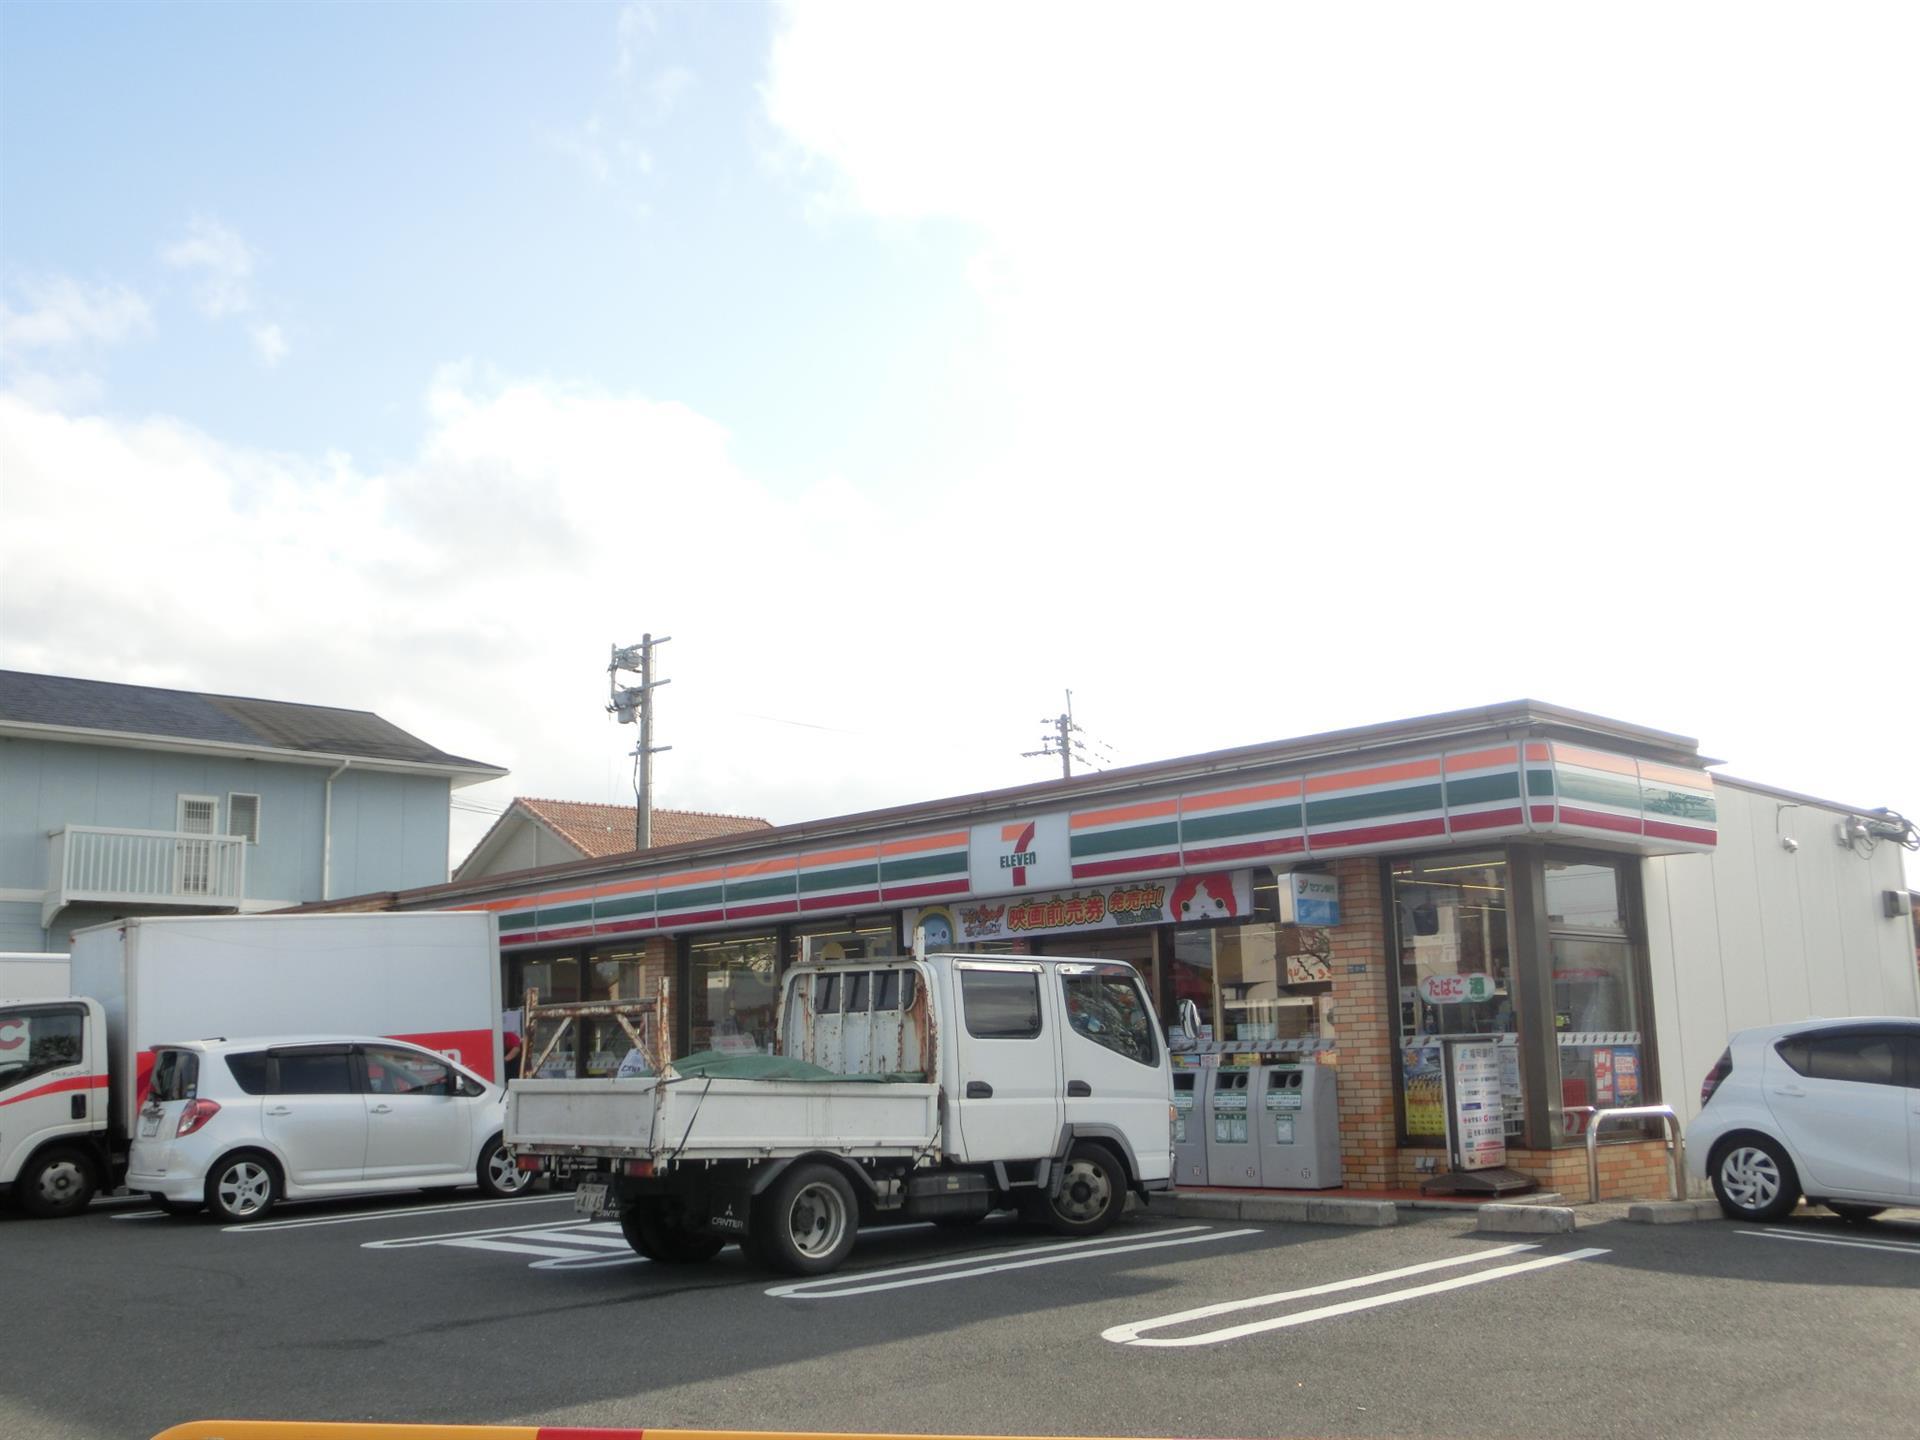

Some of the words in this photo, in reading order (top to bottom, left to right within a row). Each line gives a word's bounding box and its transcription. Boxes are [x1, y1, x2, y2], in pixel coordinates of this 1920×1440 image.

[1008, 895, 1105, 931] 映画前売券
[1429, 979, 1463, 996] たばこ
[1469, 977, 1484, 995] 酒
[711, 1217, 743, 1229] CANTER
